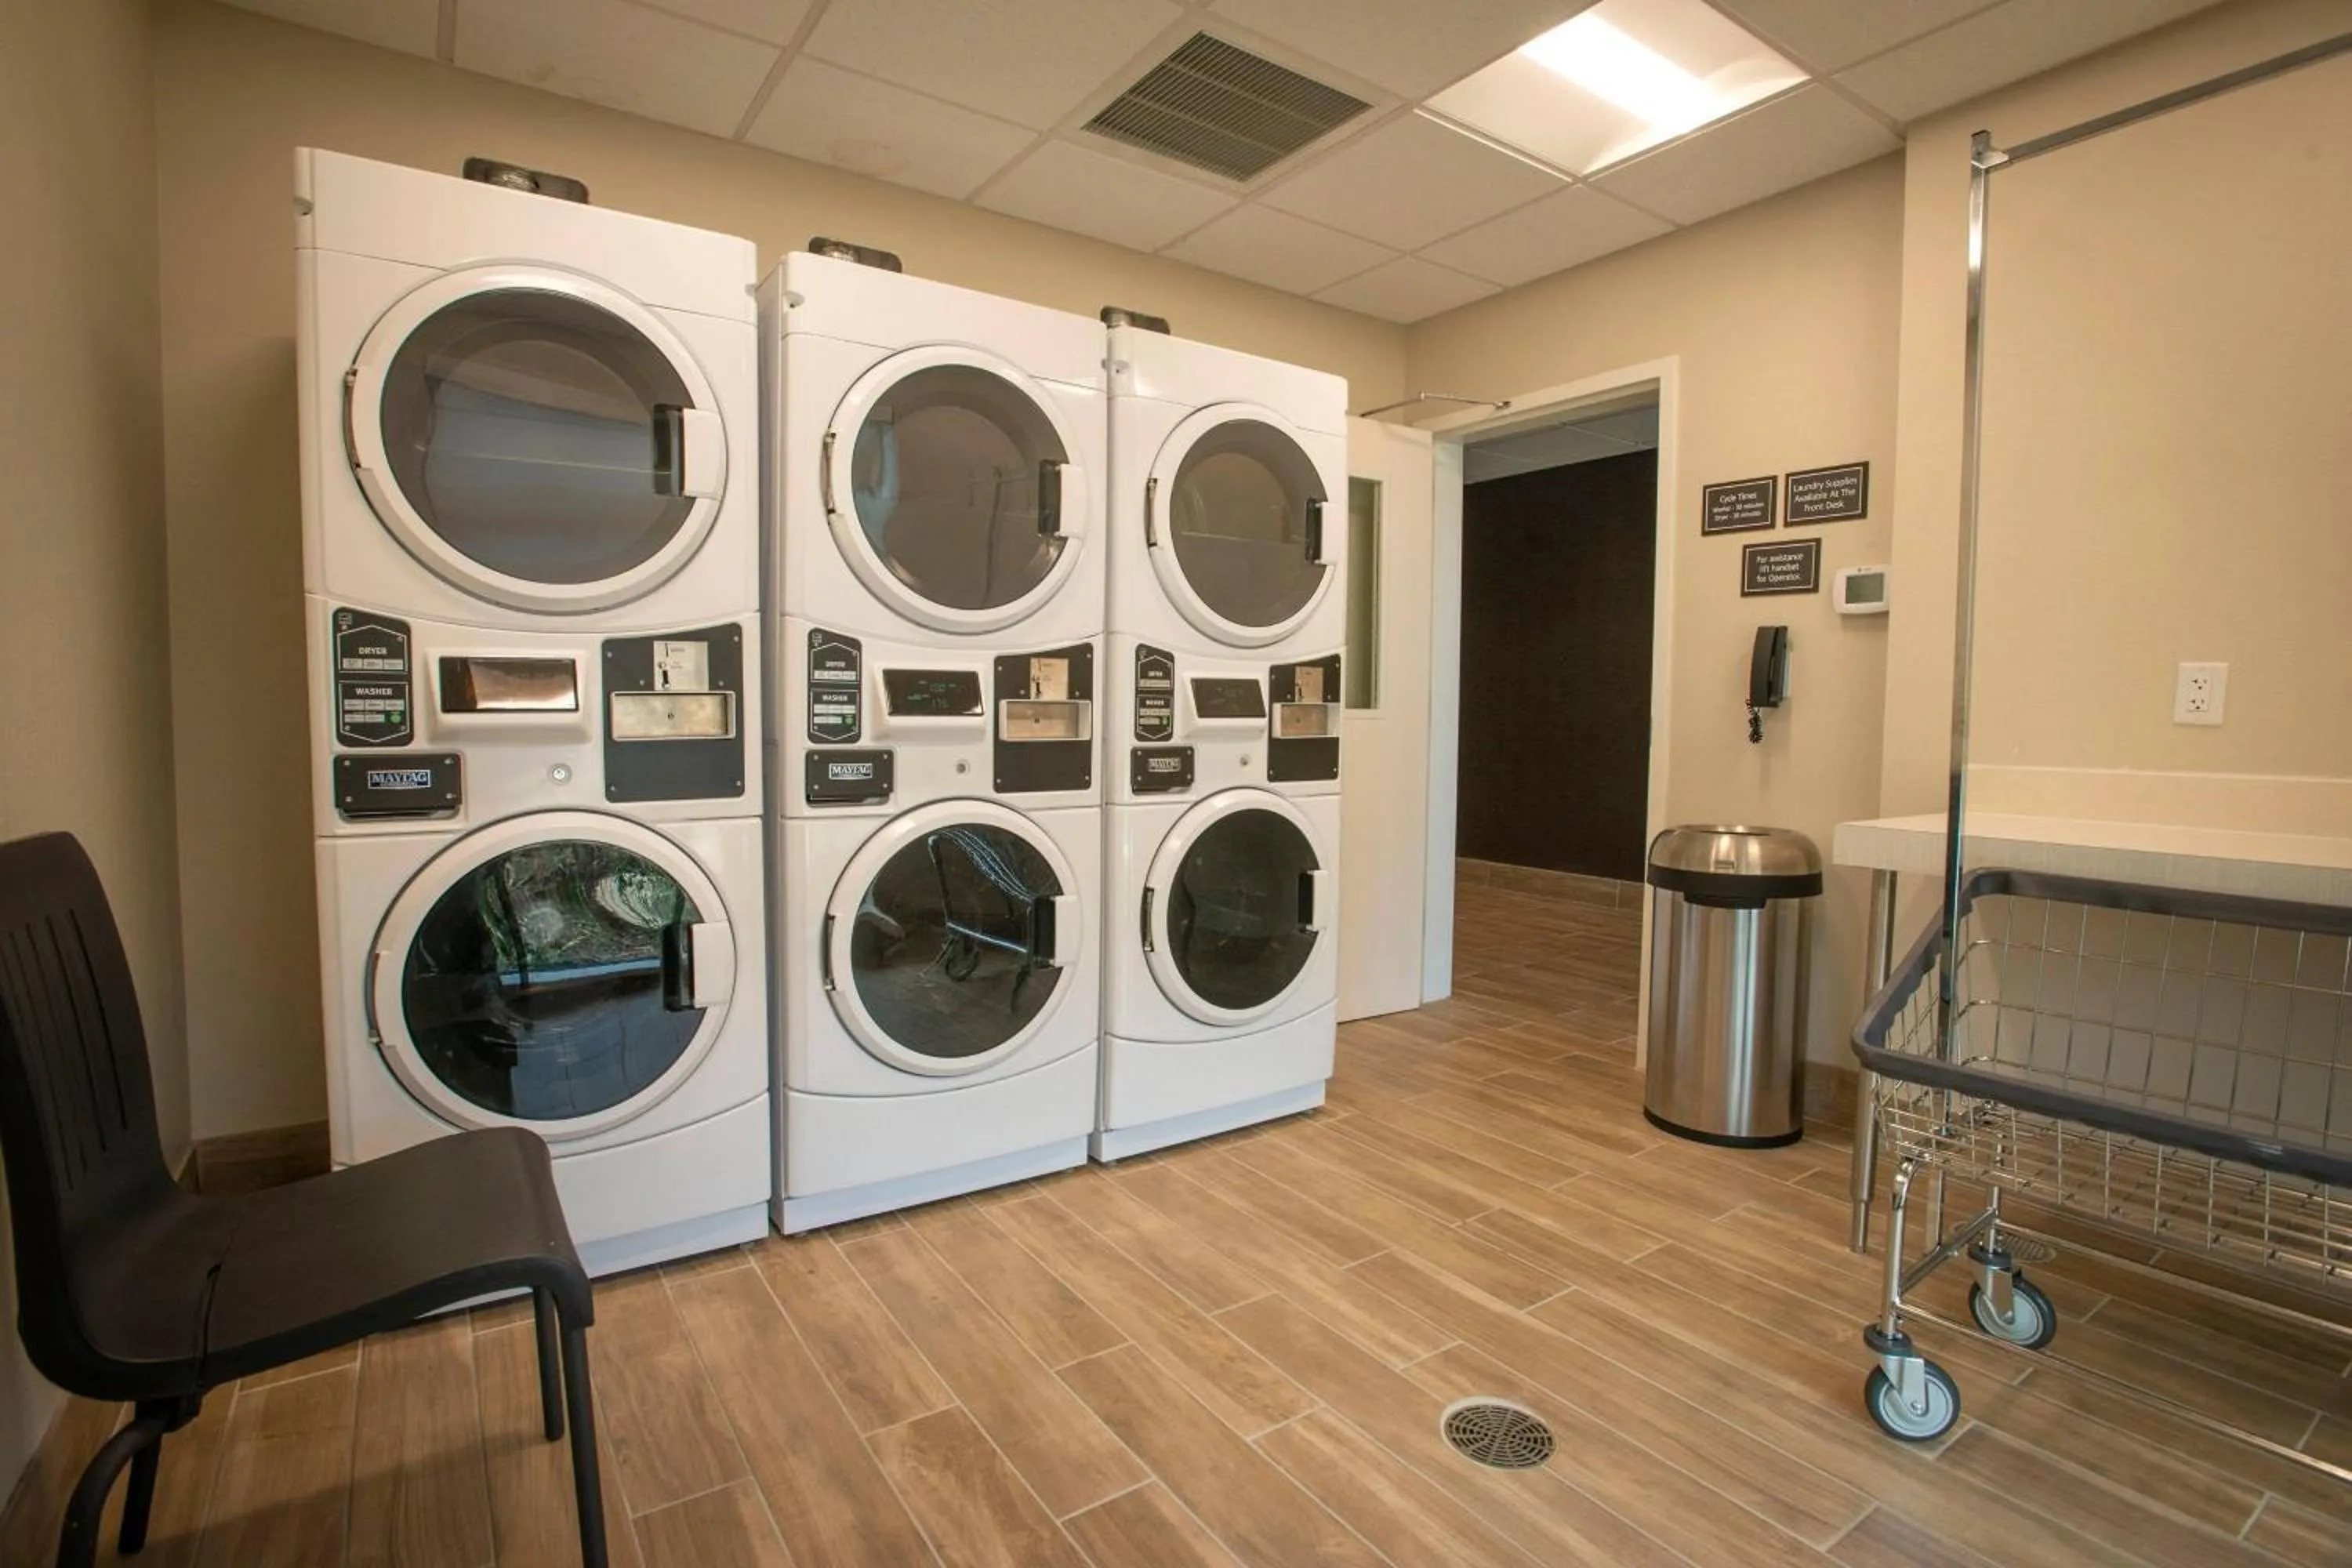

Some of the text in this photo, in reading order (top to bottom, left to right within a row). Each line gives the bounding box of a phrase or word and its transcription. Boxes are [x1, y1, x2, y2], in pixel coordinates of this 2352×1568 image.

[1793, 477, 1857, 492] Laundry Supplies
[1719, 493, 1737, 504] Cycle
[1795, 492, 1828, 503] Available
[1804, 500, 1844, 512] Front Desk
[1756, 555, 1768, 564] For
[1772, 563, 1799, 572] handset
[358, 647, 387, 655] DRYER
[355, 688, 394, 696] WASHER
[832, 765, 870, 775] MAYTAG
[371, 771, 427, 783] MAYTAG
